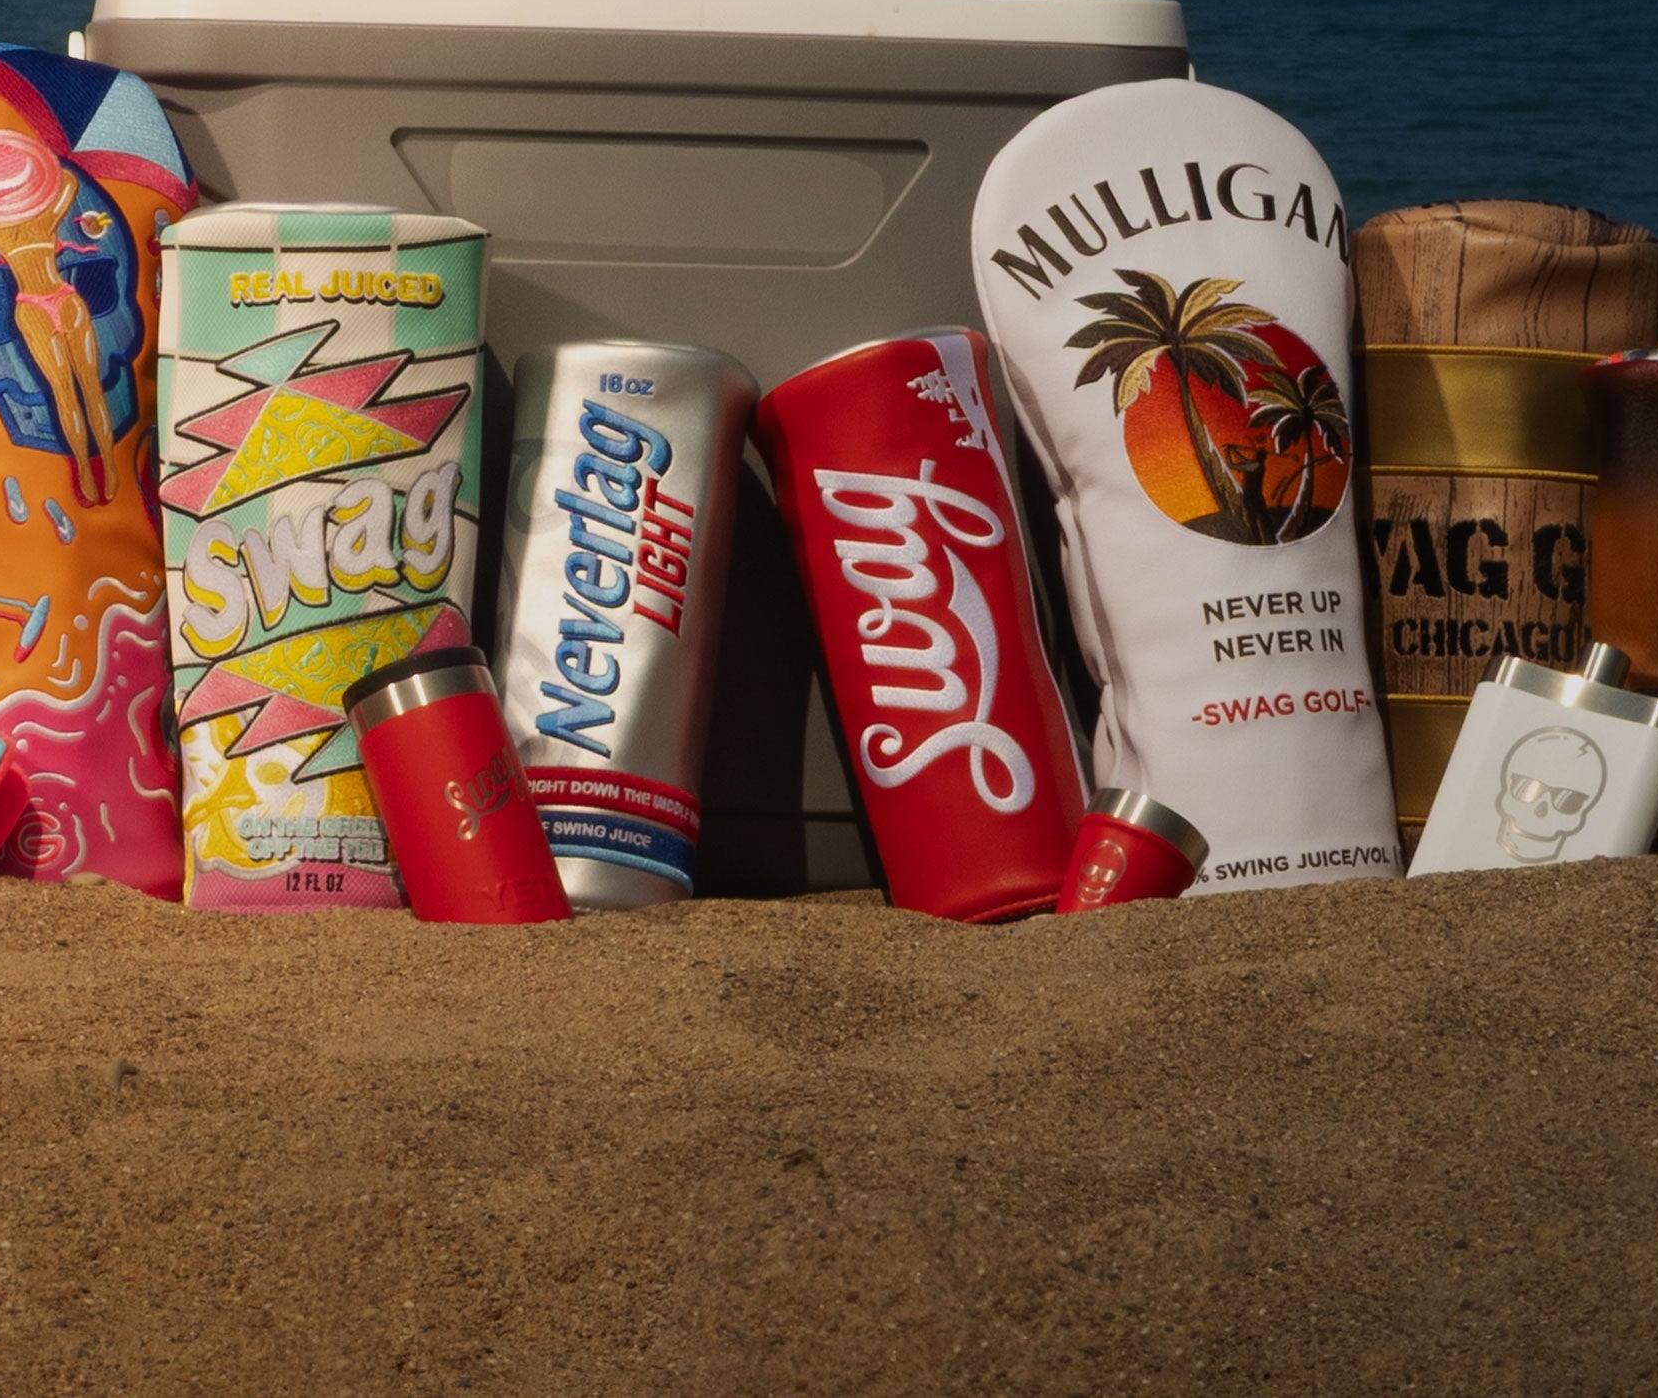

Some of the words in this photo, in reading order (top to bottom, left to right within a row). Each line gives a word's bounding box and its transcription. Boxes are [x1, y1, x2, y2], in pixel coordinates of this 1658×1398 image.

[990, 161, 1350, 302] MULLIGAN
[229, 269, 315, 308] REAL
[318, 269, 446, 309] JUICED
[180, 461, 462, 660] Swag
[633, 477, 695, 639] LIGHT
[536, 399, 672, 760] Neverlag
[1202, 591, 1304, 625] NEVER
[1311, 590, 1342, 614] UP
[813, 459, 1036, 814] Swag
[1213, 629, 1314, 662] NEVER
[1321, 628, 1344, 652] IN
[1392, 617, 1577, 663] CHICAGO
[570, 781, 619, 799] DOWN
[623, 787, 651, 806] THE
[553, 821, 607, 840] SWING
[609, 828, 652, 848] JUICE
[286, 873, 301, 892] 12
[305, 873, 322, 892] FL
[326, 873, 344, 892] OZ
[1215, 856, 1289, 881] SWING
